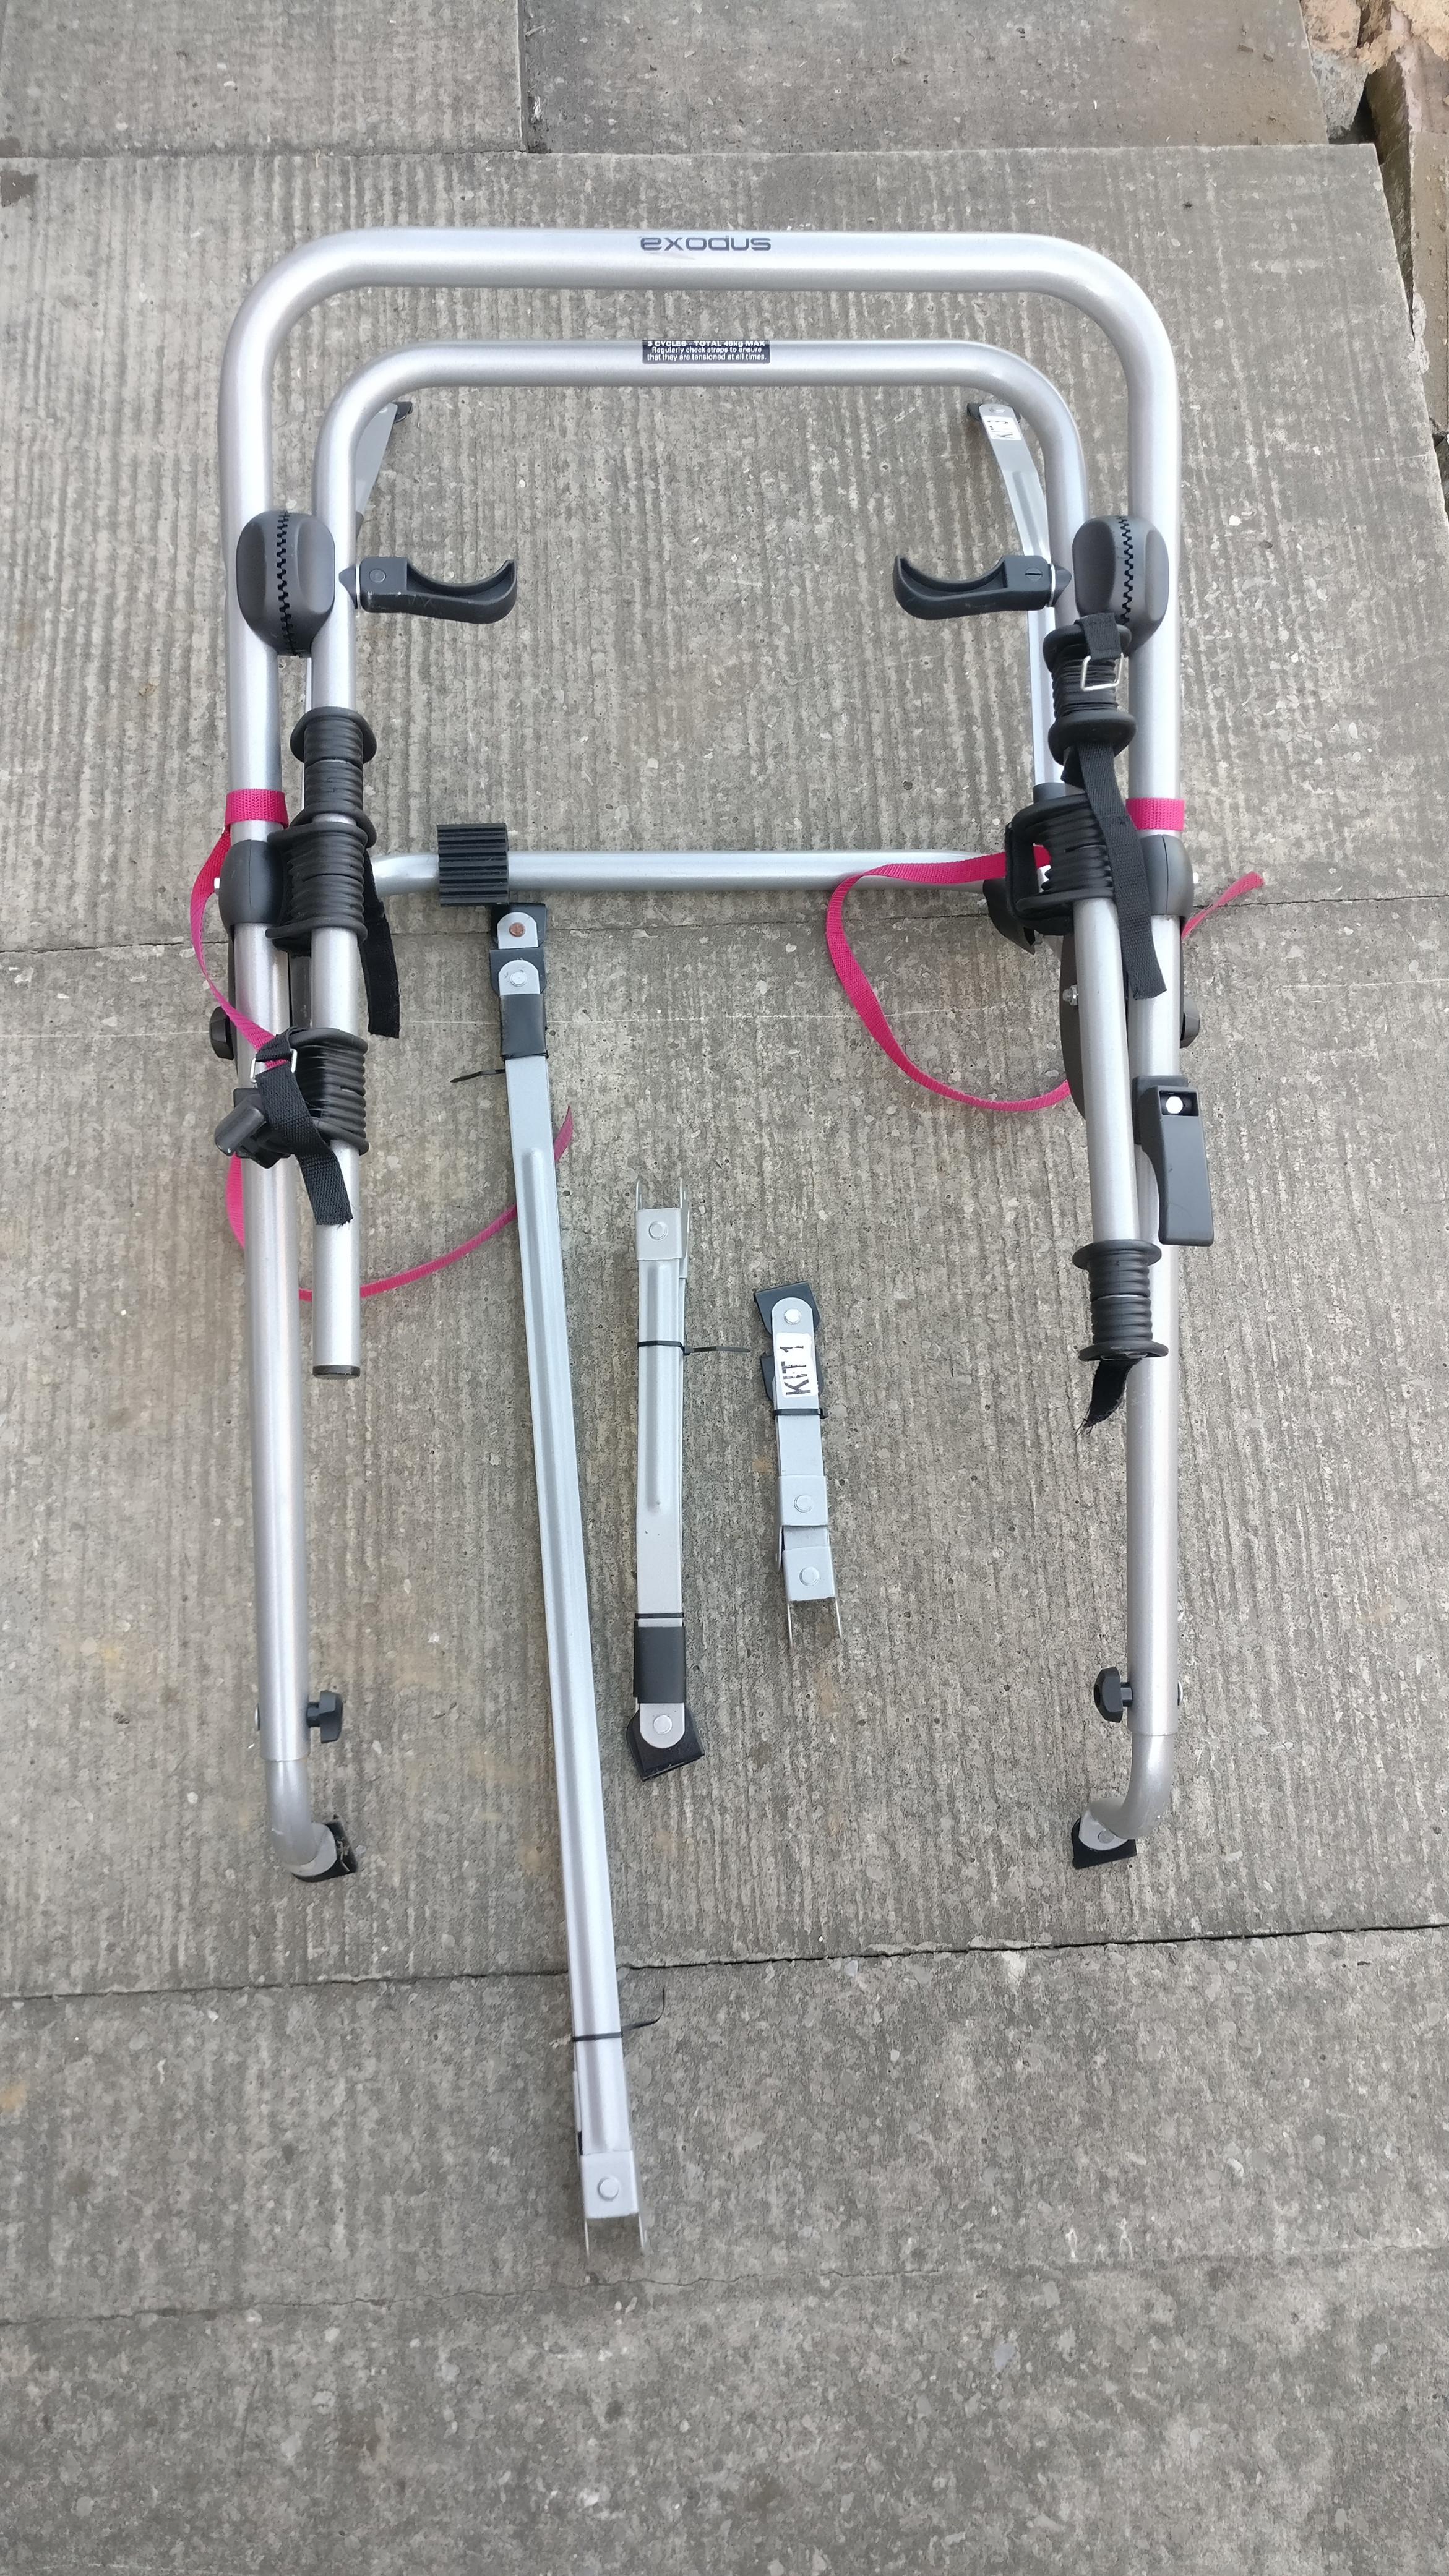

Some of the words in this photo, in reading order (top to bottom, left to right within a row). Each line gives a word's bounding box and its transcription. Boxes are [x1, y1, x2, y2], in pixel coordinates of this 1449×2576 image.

[662, 354, 678, 362] they
[779, 1345, 804, 1353] 1
[781, 1361, 811, 1396] KIT
